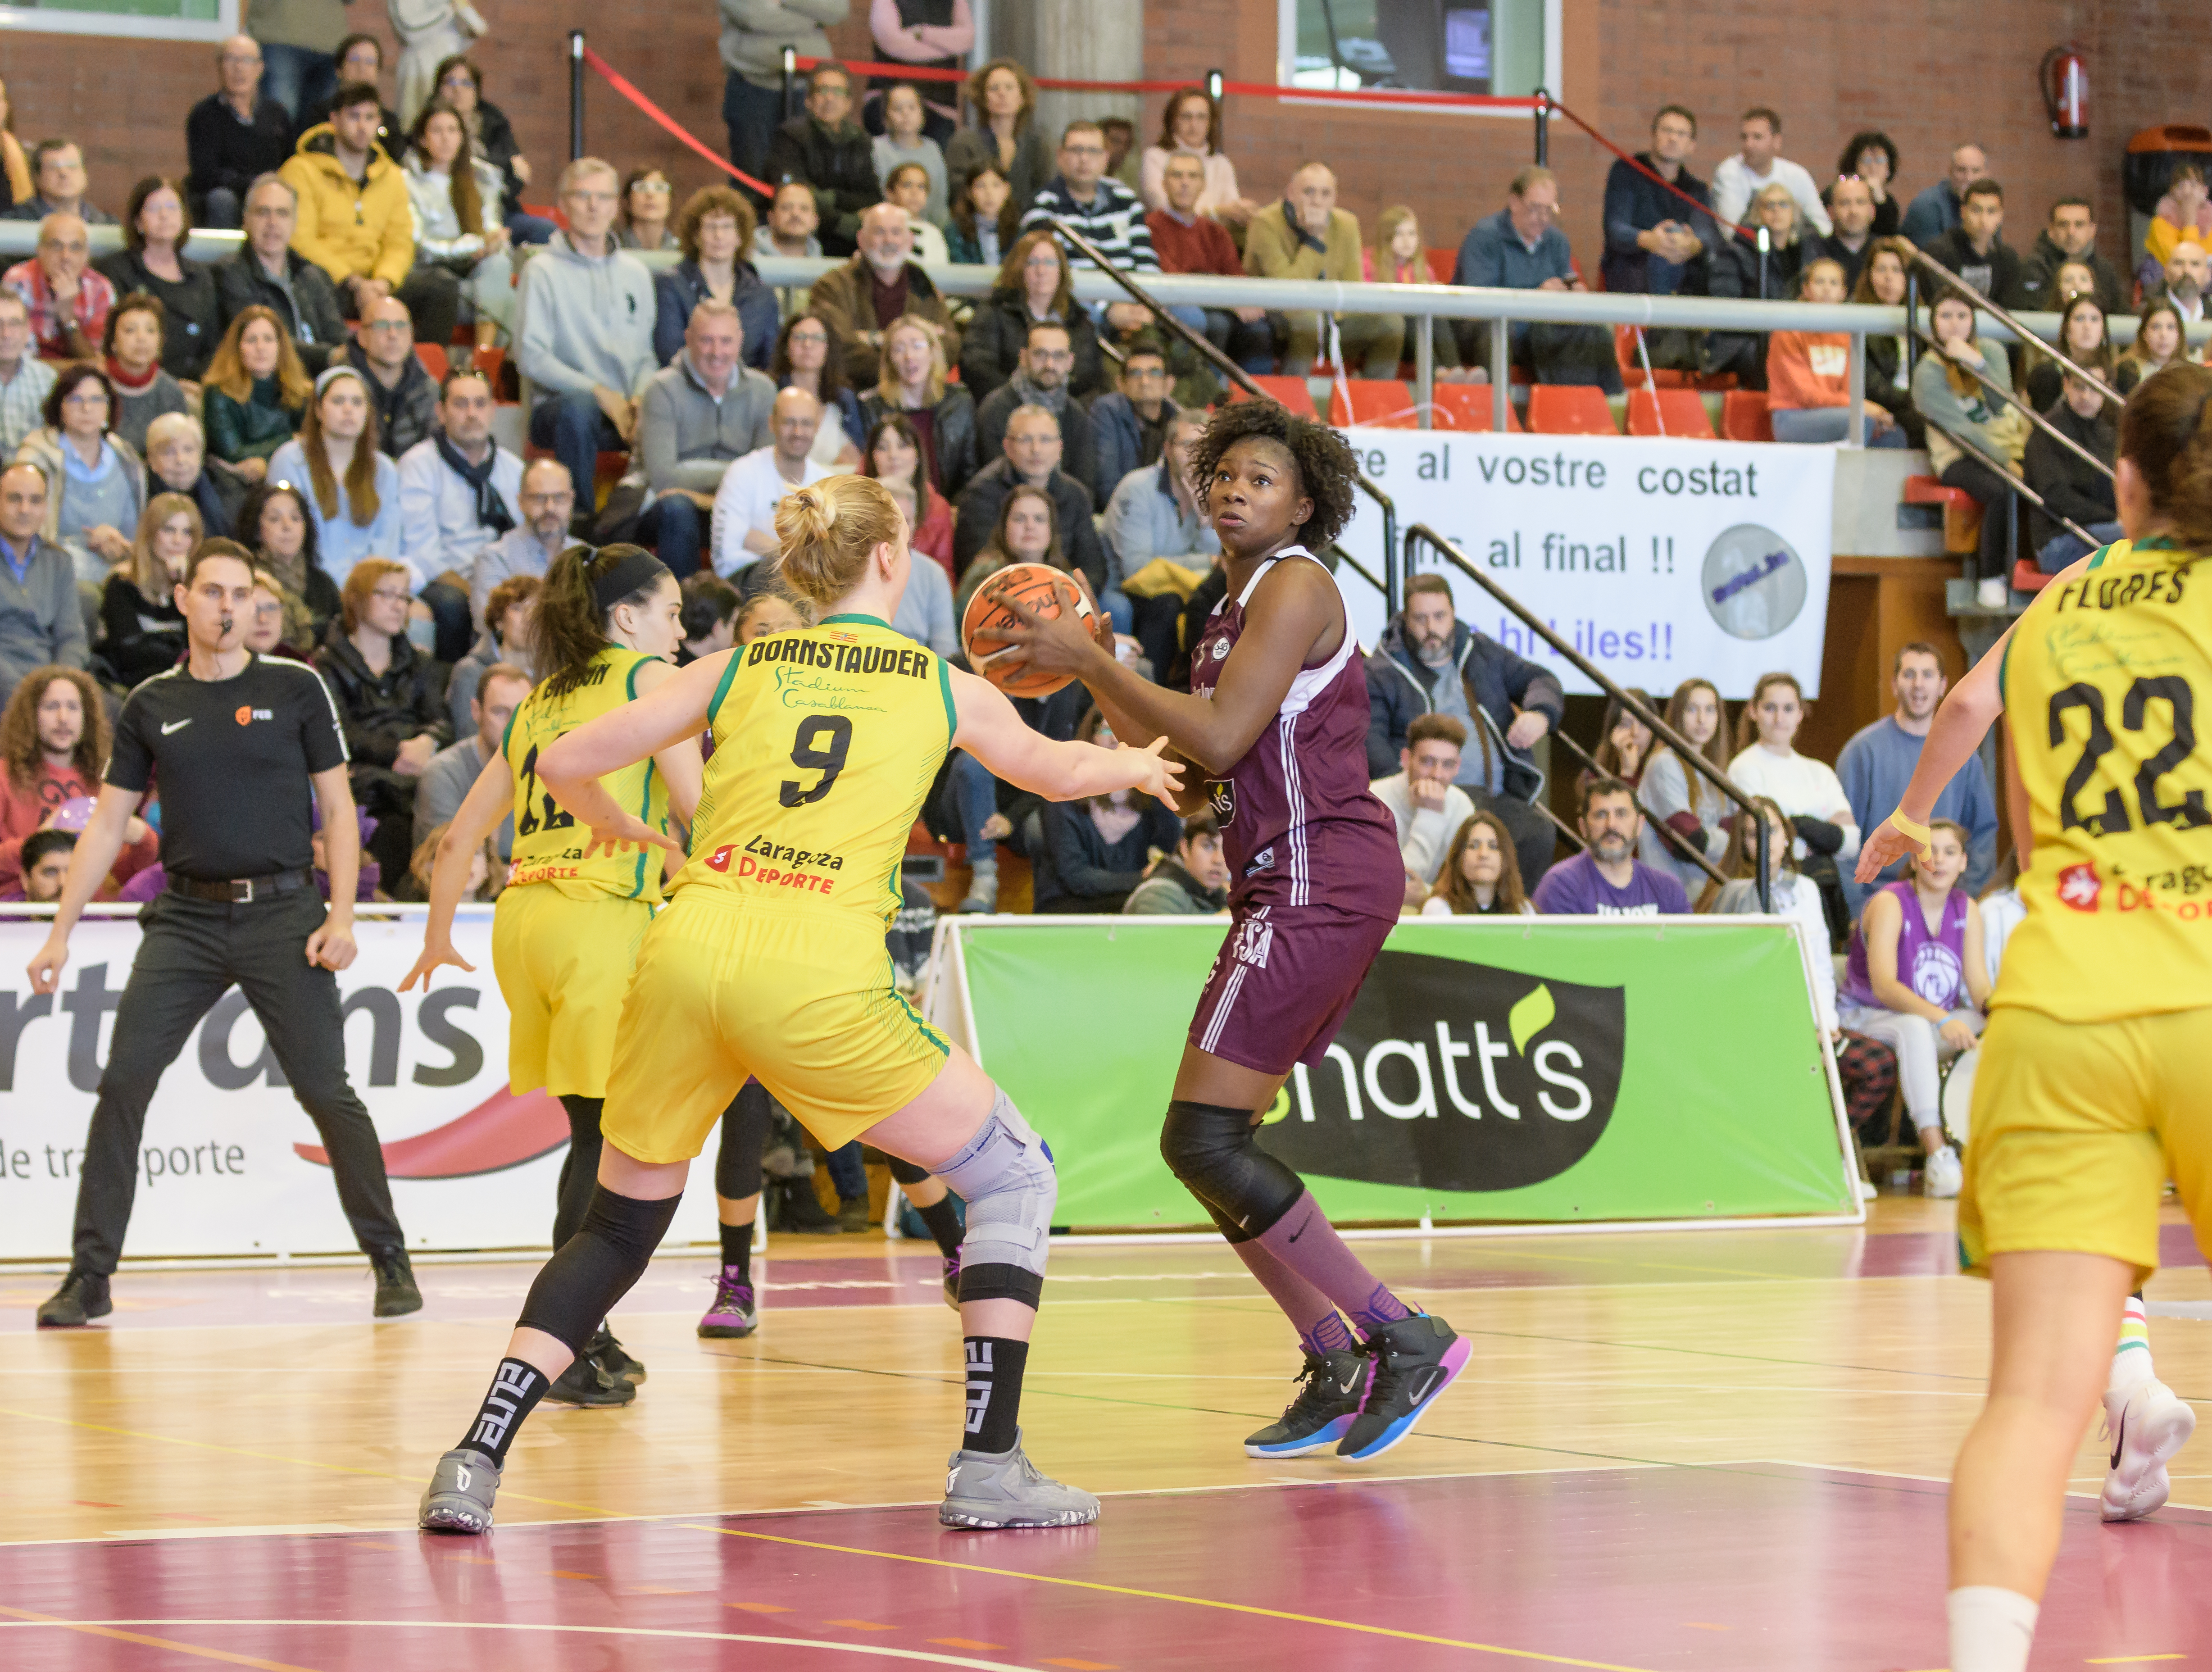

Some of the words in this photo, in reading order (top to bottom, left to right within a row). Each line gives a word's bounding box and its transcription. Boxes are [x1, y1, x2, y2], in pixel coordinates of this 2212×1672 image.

[1417, 443, 1449, 480] al
[1477, 452, 1607, 489] vostre
[1638, 459, 1758, 496] costat
[1488, 531, 1520, 568] al
[1542, 532, 1626, 572] final
[2058, 566, 2190, 613] FLORES
[748, 638, 929, 680] DORNSTAUDER
[774, 666, 870, 692] Stadium
[782, 689, 888, 713] Casablanca
[778, 714, 853, 808] 9
[2048, 676, 2212, 838] 22
[738, 856, 835, 895] DEPORTE
[0, 962, 485, 1095] rtans
[44, 1140, 245, 1187] trporte
